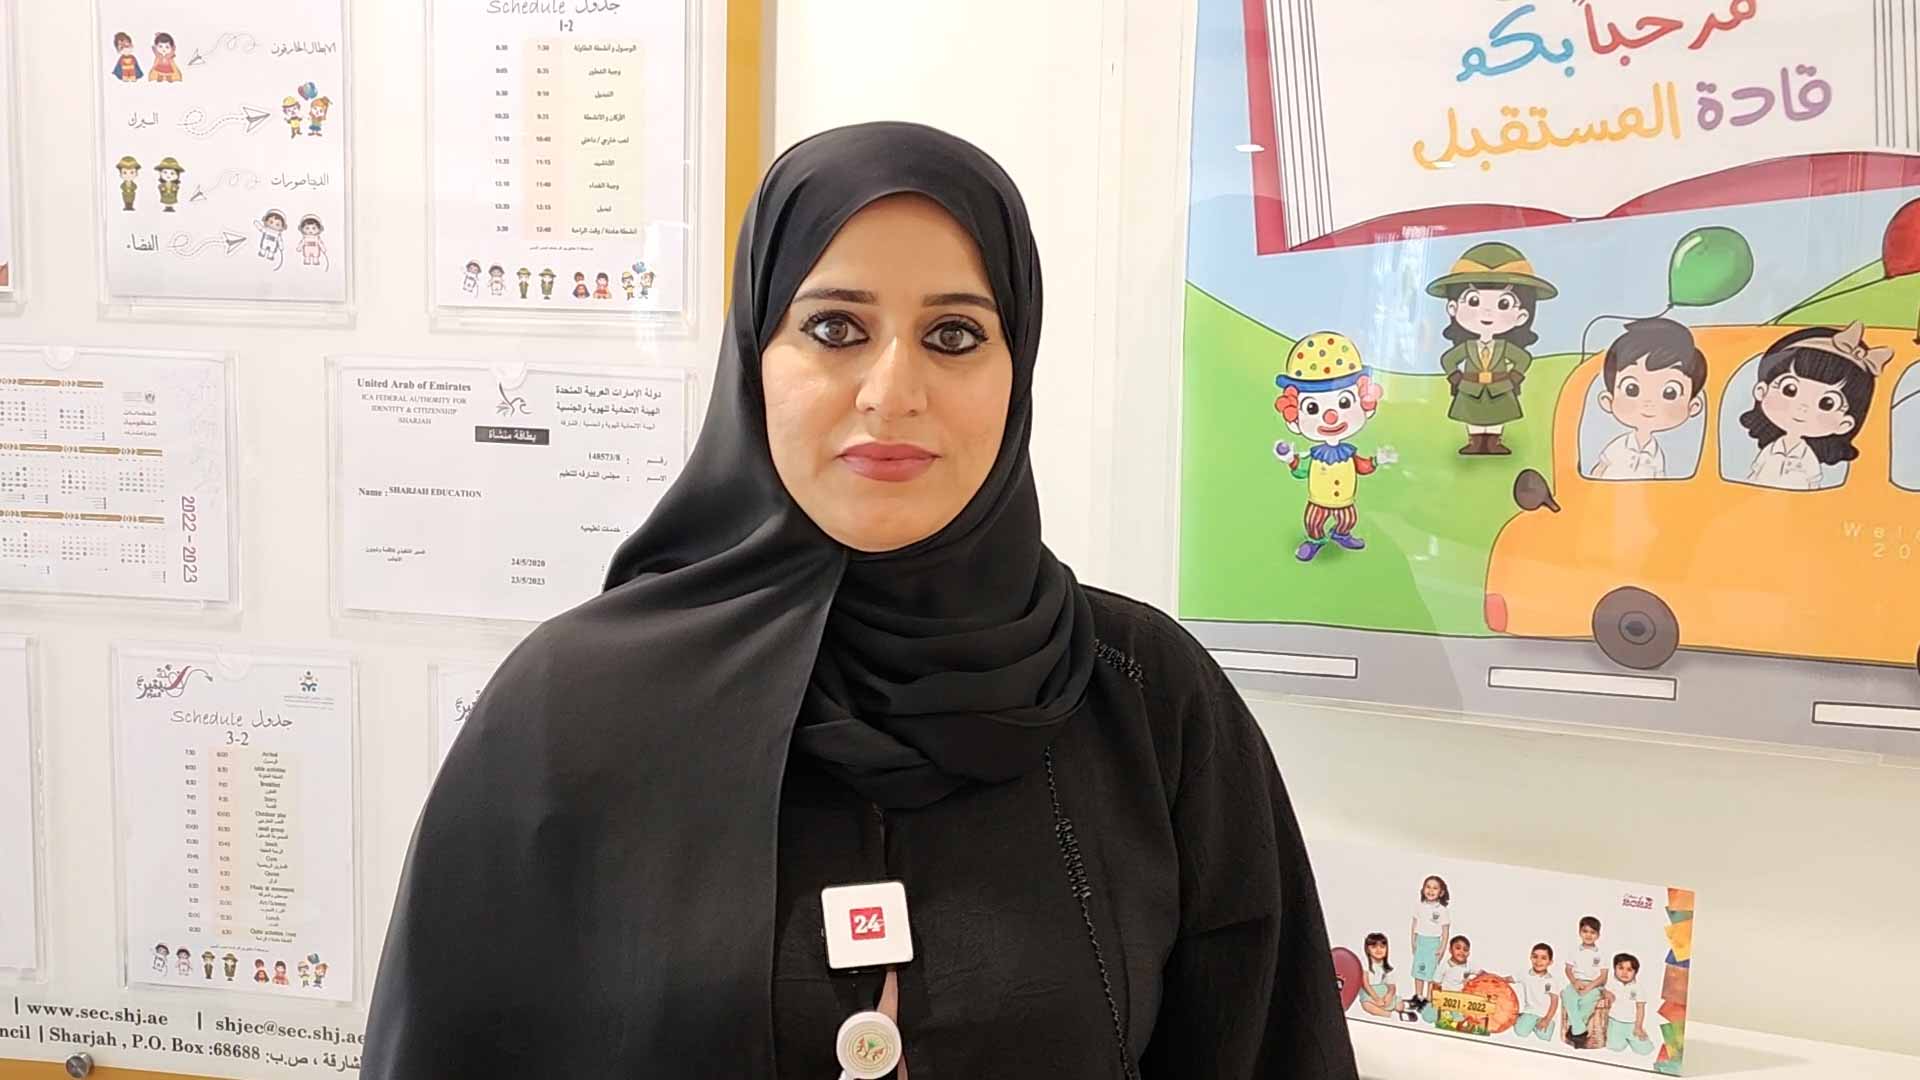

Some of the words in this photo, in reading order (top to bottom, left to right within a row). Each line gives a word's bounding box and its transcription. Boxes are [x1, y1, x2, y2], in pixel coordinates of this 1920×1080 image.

[559, 19, 574, 31] 1-2
[1456, 3, 1575, 82] بكم
[1696, 64, 1832, 131] قادة
[1412, 81, 1681, 171] المستقبل
[357, 378, 388, 388] United
[391, 379, 415, 390] Arab
[417, 379, 428, 390] of
[429, 381, 472, 392] Emirates
[556, 385, 582, 395] المتحدة
[584, 385, 610, 397] العربية
[410, 396, 450, 404] AUTHORITY
[452, 396, 467, 404] FOR
[644, 387, 661, 400] دولة
[371, 405, 404, 413] IDENTITY
[413, 407, 458, 415] CITIZENSHIP
[399, 417, 432, 425] SHARJAH
[514, 430, 537, 443] بطاقة
[358, 487, 382, 497] Name
[388, 486, 429, 496] SHARJAH
[431, 488, 482, 498] EDUCATION
[181, 495, 198, 532] 2022
[182, 546, 198, 583] 2023
[511, 557, 546, 567] 24/5/2020
[511, 576, 546, 586] 23/5/2023
[170, 710, 243, 727] Schedule
[251, 709, 293, 730] جدول
[226, 730, 249, 746] 3-2
[854, 914, 880, 934] 24
[27, 1003, 168, 1026] www.sec.shj.ae
[215, 1016, 366, 1045] shjec@sec.shj.ae
[50, 1027, 117, 1048] Sharjah
[132, 1034, 167, 1051] P.O.
[172, 1037, 204, 1055] Box
